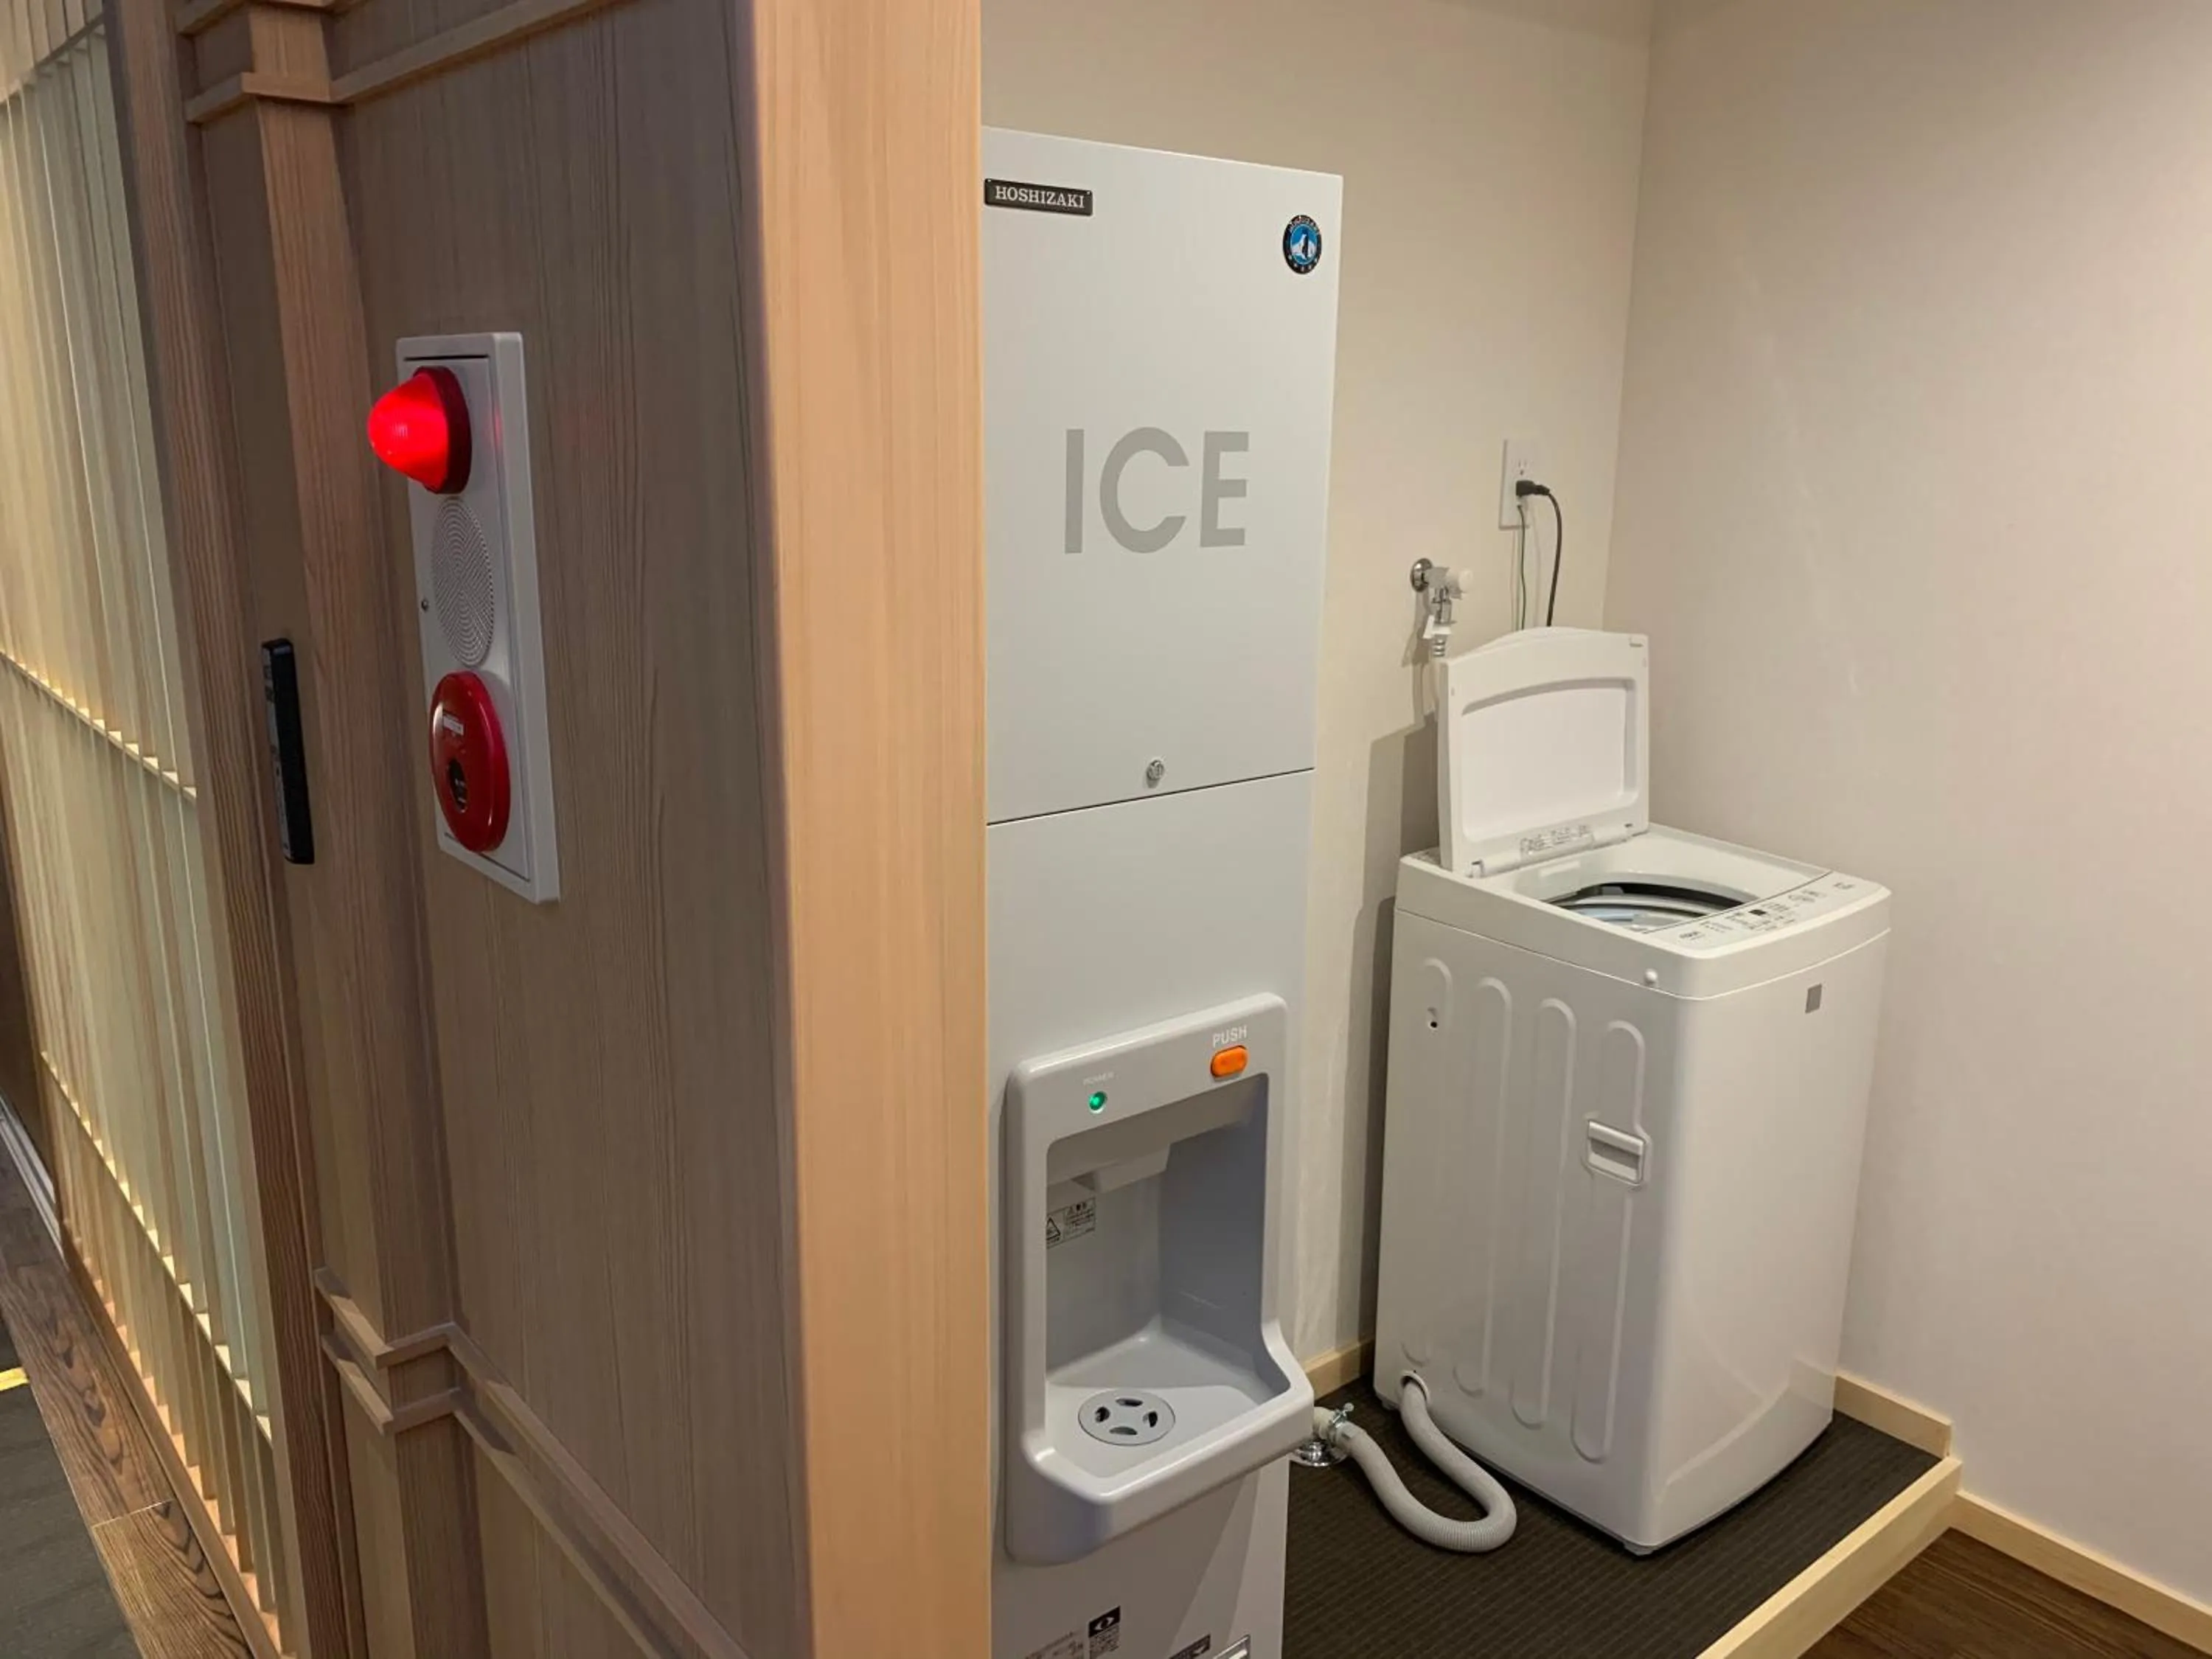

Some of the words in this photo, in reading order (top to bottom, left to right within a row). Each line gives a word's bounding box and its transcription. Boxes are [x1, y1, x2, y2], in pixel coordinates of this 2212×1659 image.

[995, 186, 1085, 208] HOSHIZAKI
[1065, 427, 1249, 554] ICE
[1213, 1025, 1247, 1048] PUSH
